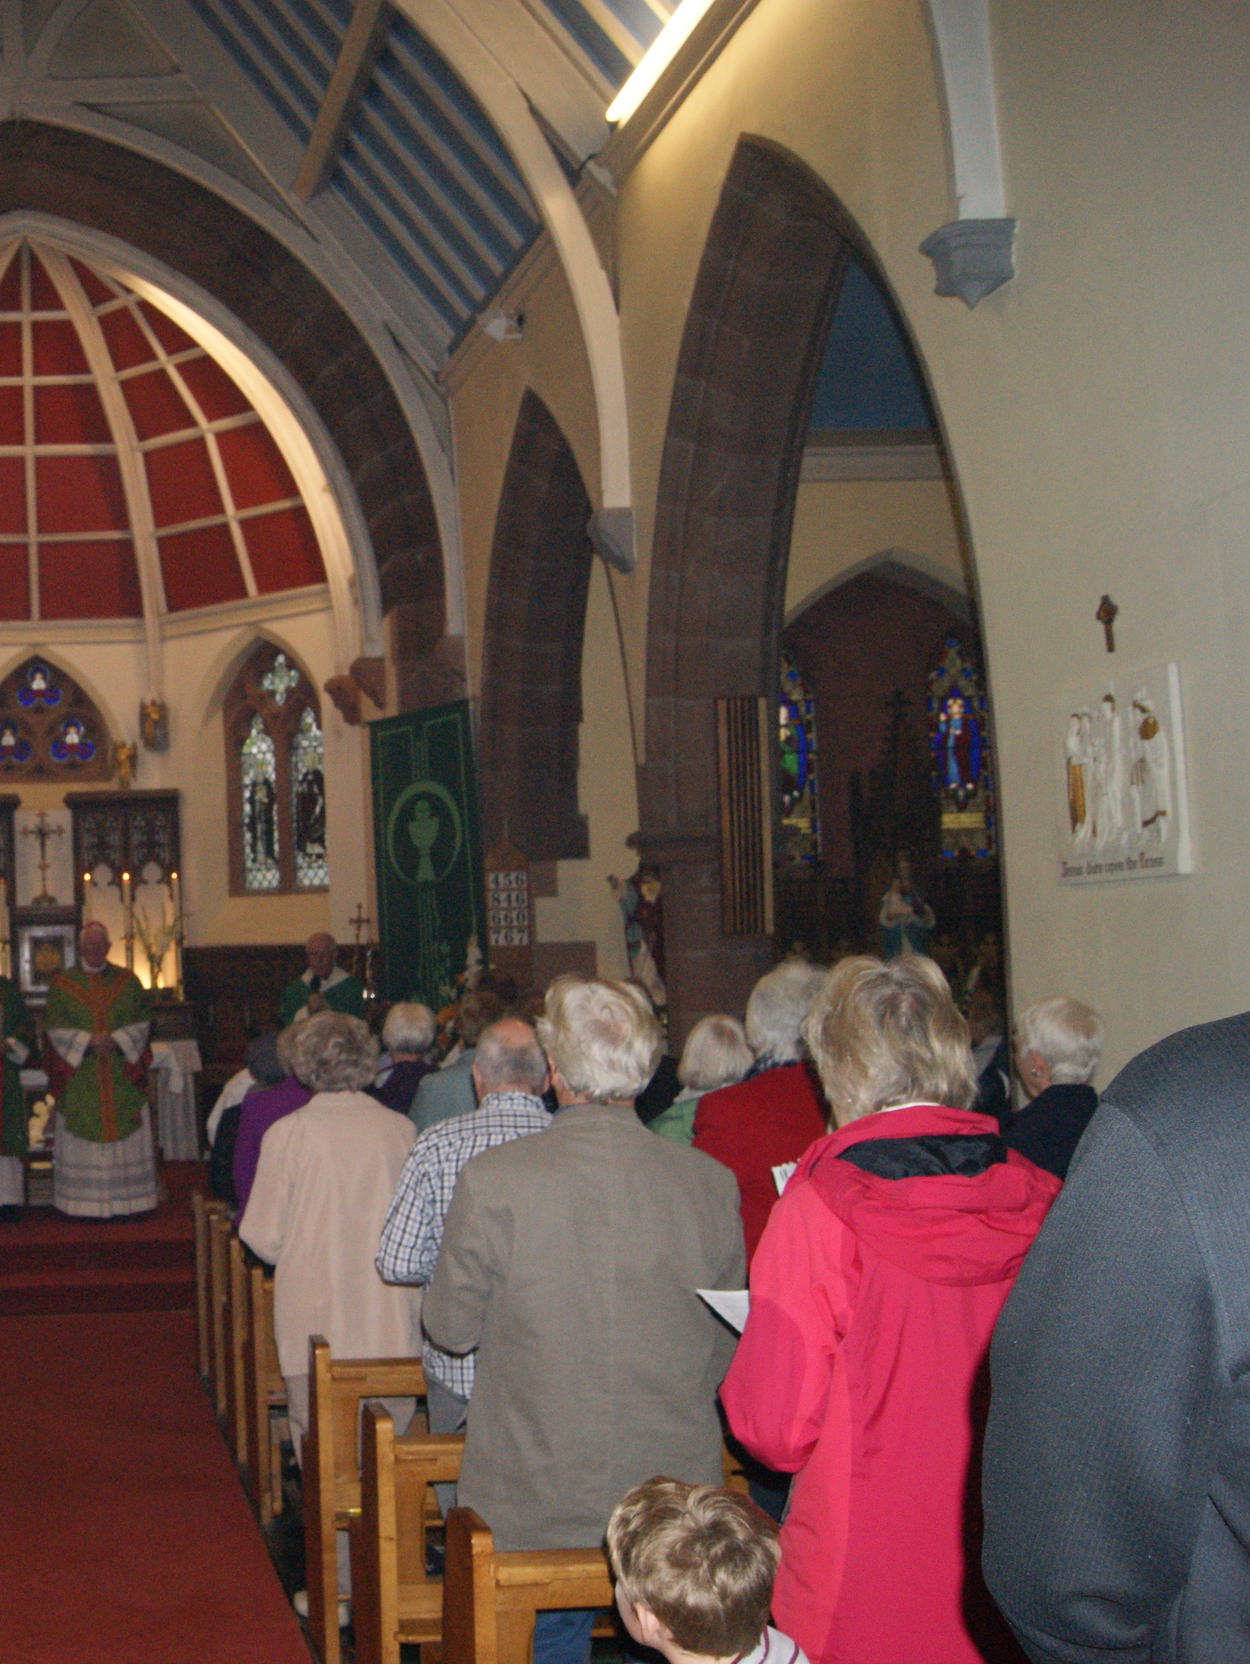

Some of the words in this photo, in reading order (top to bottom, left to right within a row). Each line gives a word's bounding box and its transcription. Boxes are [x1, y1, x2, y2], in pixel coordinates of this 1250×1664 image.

[491, 873, 525, 888] 456
[491, 891, 525, 906] 846
[491, 911, 526, 925] 660
[492, 929, 525, 944] 767
